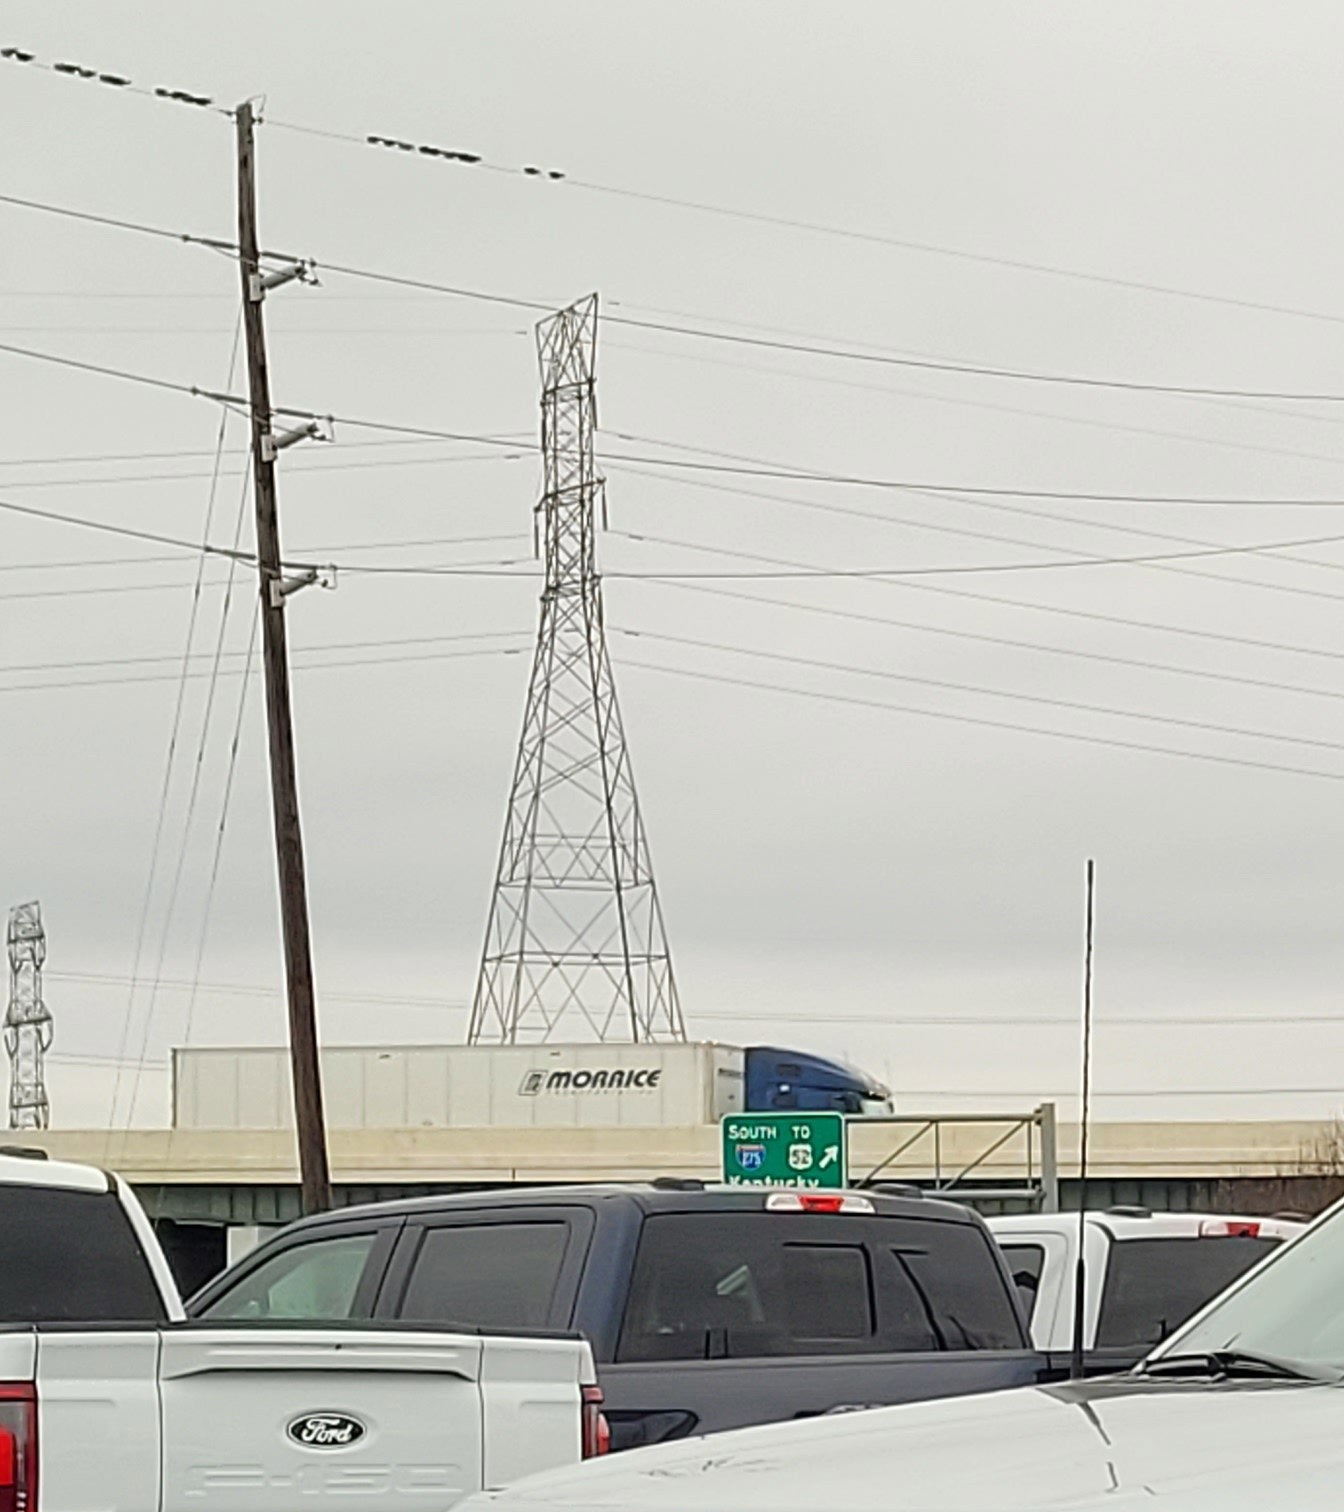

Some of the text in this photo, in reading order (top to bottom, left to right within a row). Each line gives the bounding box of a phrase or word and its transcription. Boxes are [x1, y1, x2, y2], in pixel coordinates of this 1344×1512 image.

[728, 1125, 811, 1139] SOUTH TO
[302, 1418, 352, 1443] Ford
